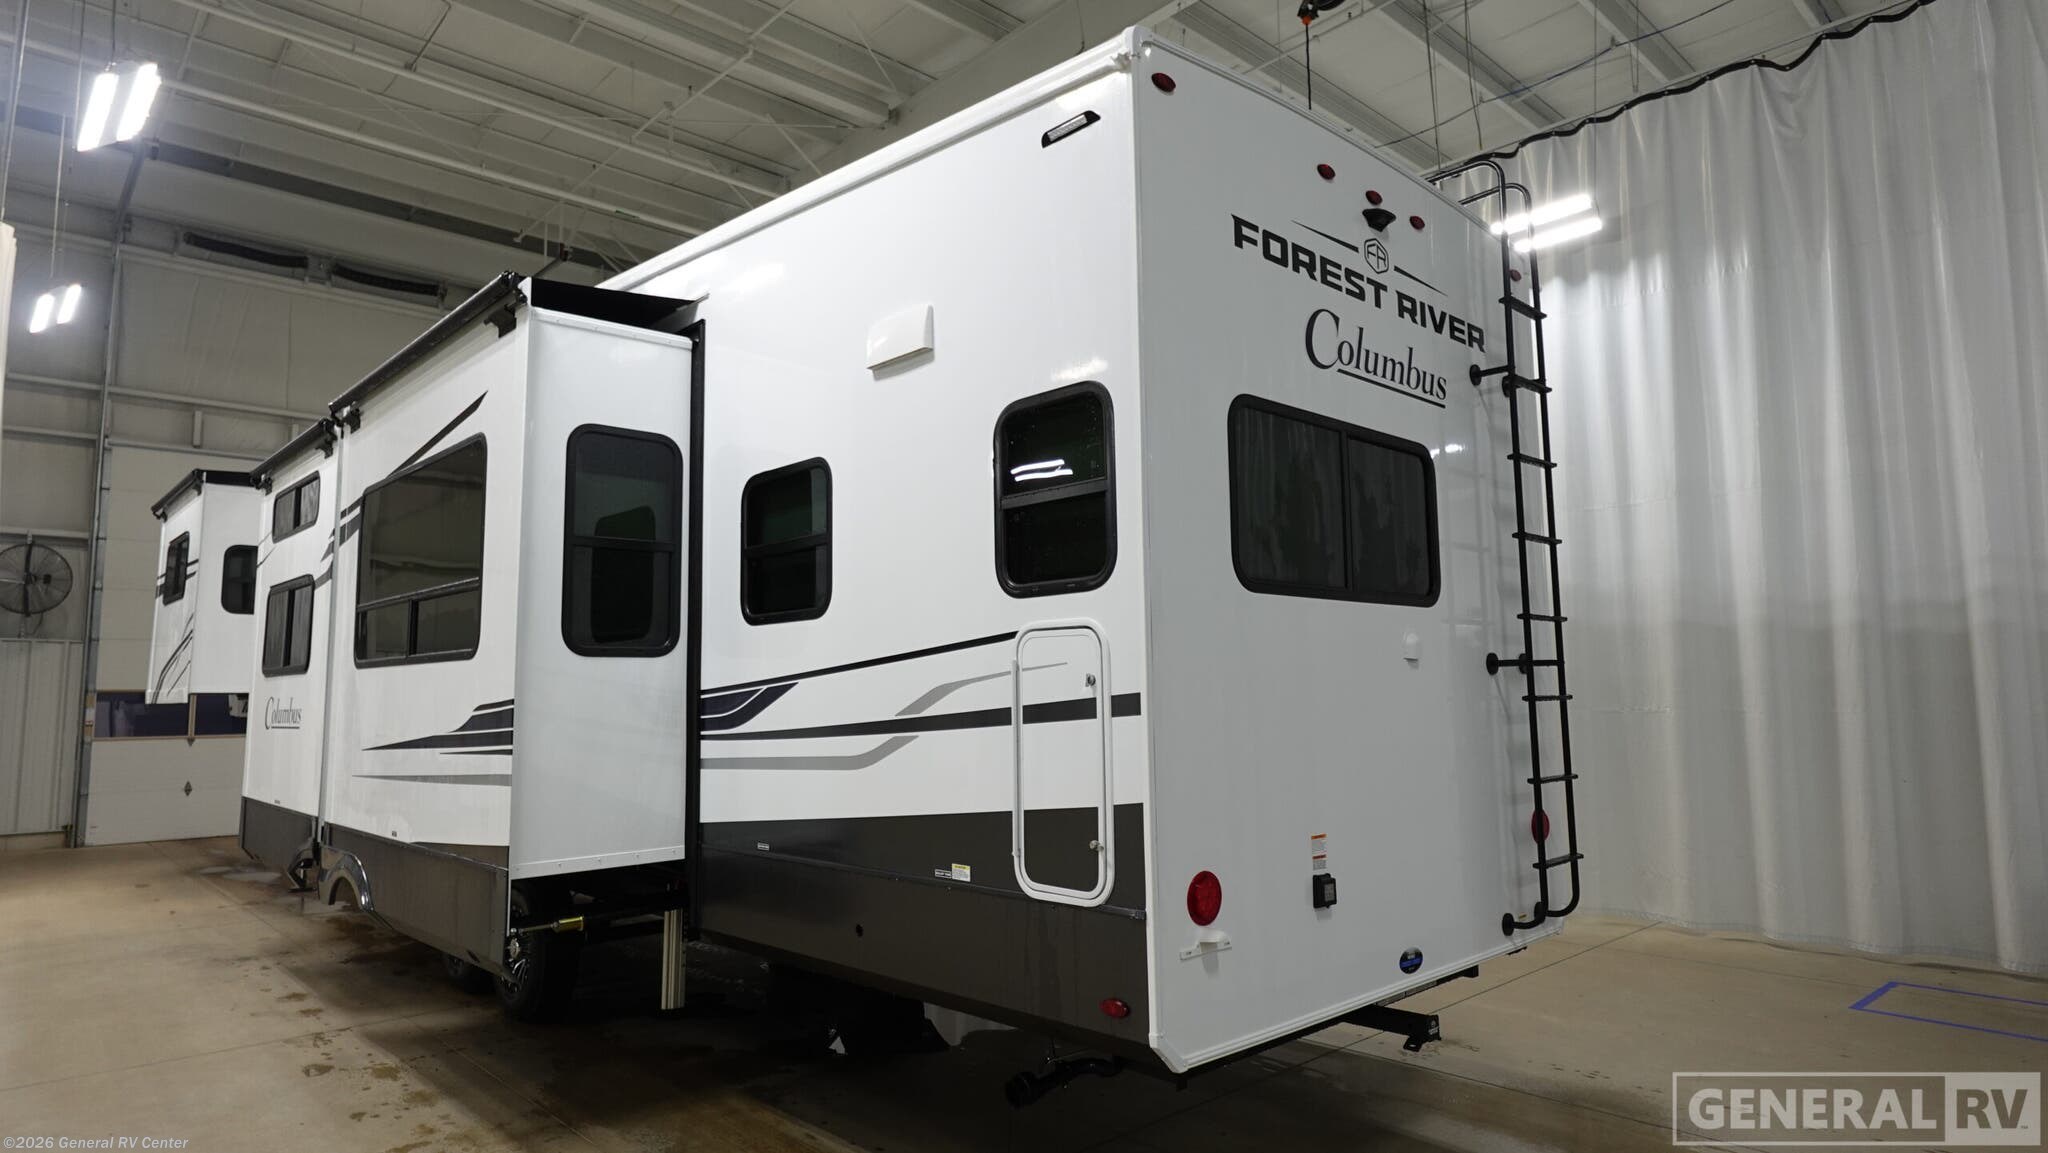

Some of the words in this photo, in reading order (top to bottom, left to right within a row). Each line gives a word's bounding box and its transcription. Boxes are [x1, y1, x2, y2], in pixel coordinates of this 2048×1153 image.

[1231, 214, 1387, 309] FOREST
[1396, 290, 1486, 353] RIVER
[1305, 308, 1447, 401] Columbus
[265, 696, 302, 730] Columbus
